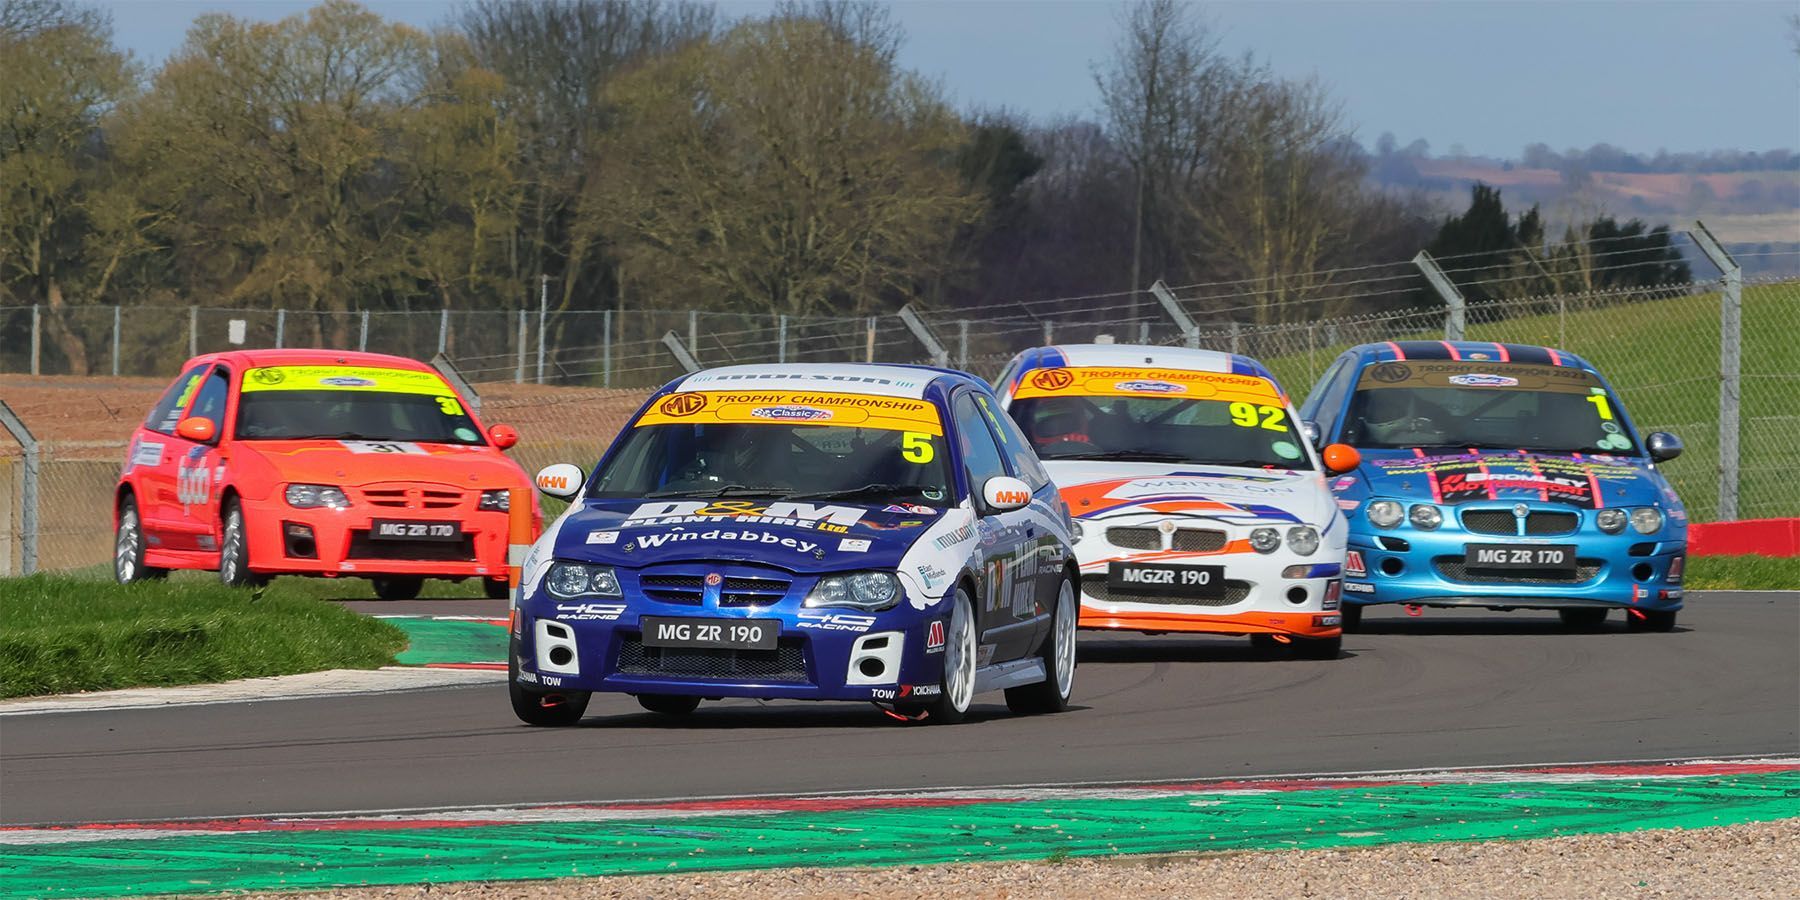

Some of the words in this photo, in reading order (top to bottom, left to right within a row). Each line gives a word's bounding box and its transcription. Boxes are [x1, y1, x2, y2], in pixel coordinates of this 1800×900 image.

[1033, 369, 1072, 389] MG
[1147, 371, 1262, 387] CHAMPIONSHIP
[1419, 365, 1470, 373] TROPHY
[1477, 366, 1550, 376] CHAMPION
[435, 397, 464, 416] 31
[663, 393, 705, 415] MG
[716, 395, 786, 403] TROPHY
[791, 395, 924, 412] CHAMPIONSHIP
[1586, 395, 1613, 420] 1
[772, 409, 811, 418] Classic
[1229, 402, 1288, 432] 92
[902, 431, 934, 464] 5
[1132, 480, 1238, 490] WRITE
[1245, 485, 1294, 493] ON
[627, 501, 868, 527] D&M
[380, 523, 406, 535] MG
[407, 525, 428, 536] ZR
[430, 525, 454, 537] 170
[622, 514, 727, 528] PLANT
[734, 515, 815, 529] HIRE
[818, 522, 848, 534] Ltd.
[1478, 549, 1507, 563] MG
[1509, 550, 1533, 563] ZR
[1537, 550, 1564, 564] 170
[1123, 568, 1175, 584] MGZR
[1180, 570, 1210, 585] 190
[658, 624, 691, 640] MG
[696, 625, 722, 640] ZR
[730, 626, 762, 642] 190
[796, 622, 870, 632] RACING
[542, 676, 562, 687] TOW
[913, 684, 942, 696] YOKOHAMA
[871, 688, 895, 700] TOW
